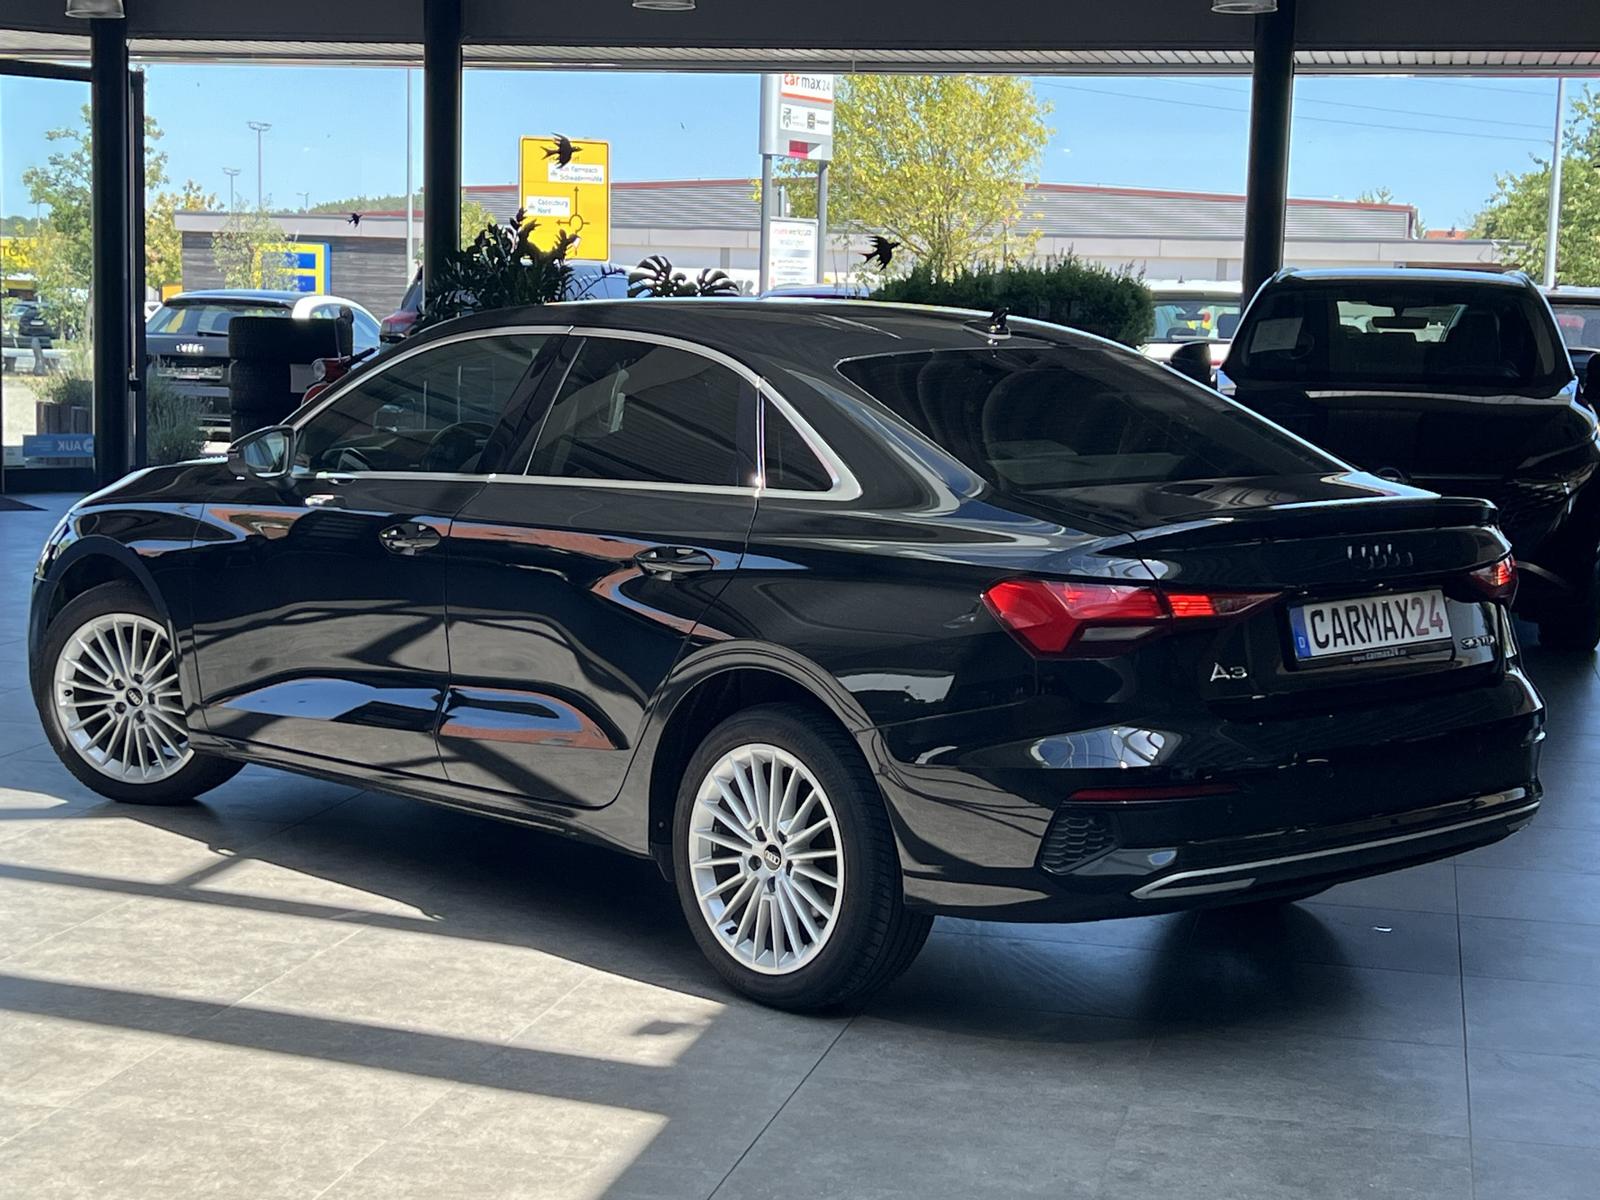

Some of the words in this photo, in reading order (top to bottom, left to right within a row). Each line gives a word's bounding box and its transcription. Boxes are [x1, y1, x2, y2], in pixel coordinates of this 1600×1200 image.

[1298, 635, 1306, 649] D
[1310, 595, 1444, 649] CARMAX24
[1210, 661, 1248, 681] A3
